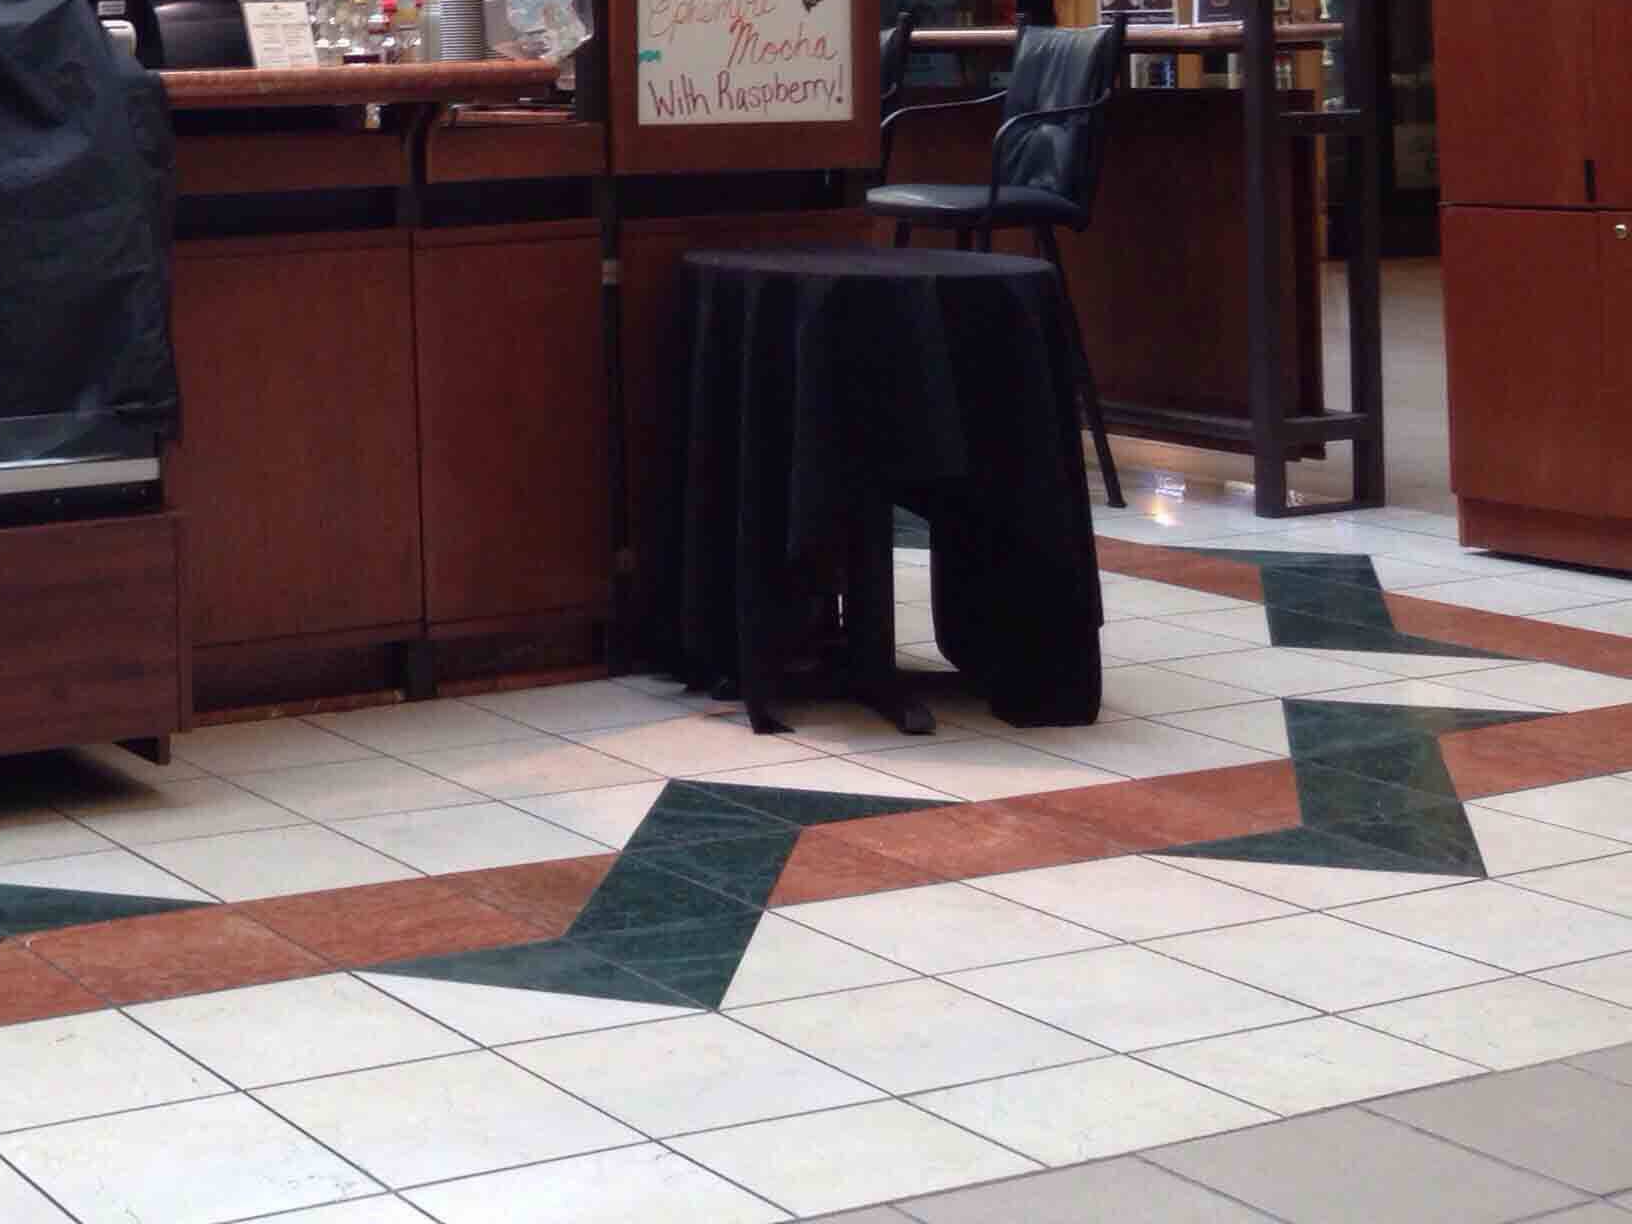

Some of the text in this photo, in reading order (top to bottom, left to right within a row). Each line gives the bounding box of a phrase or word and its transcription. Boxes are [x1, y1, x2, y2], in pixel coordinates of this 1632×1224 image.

[728, 18, 838, 69] Mocha
[648, 64, 844, 118] With Raspberry!
